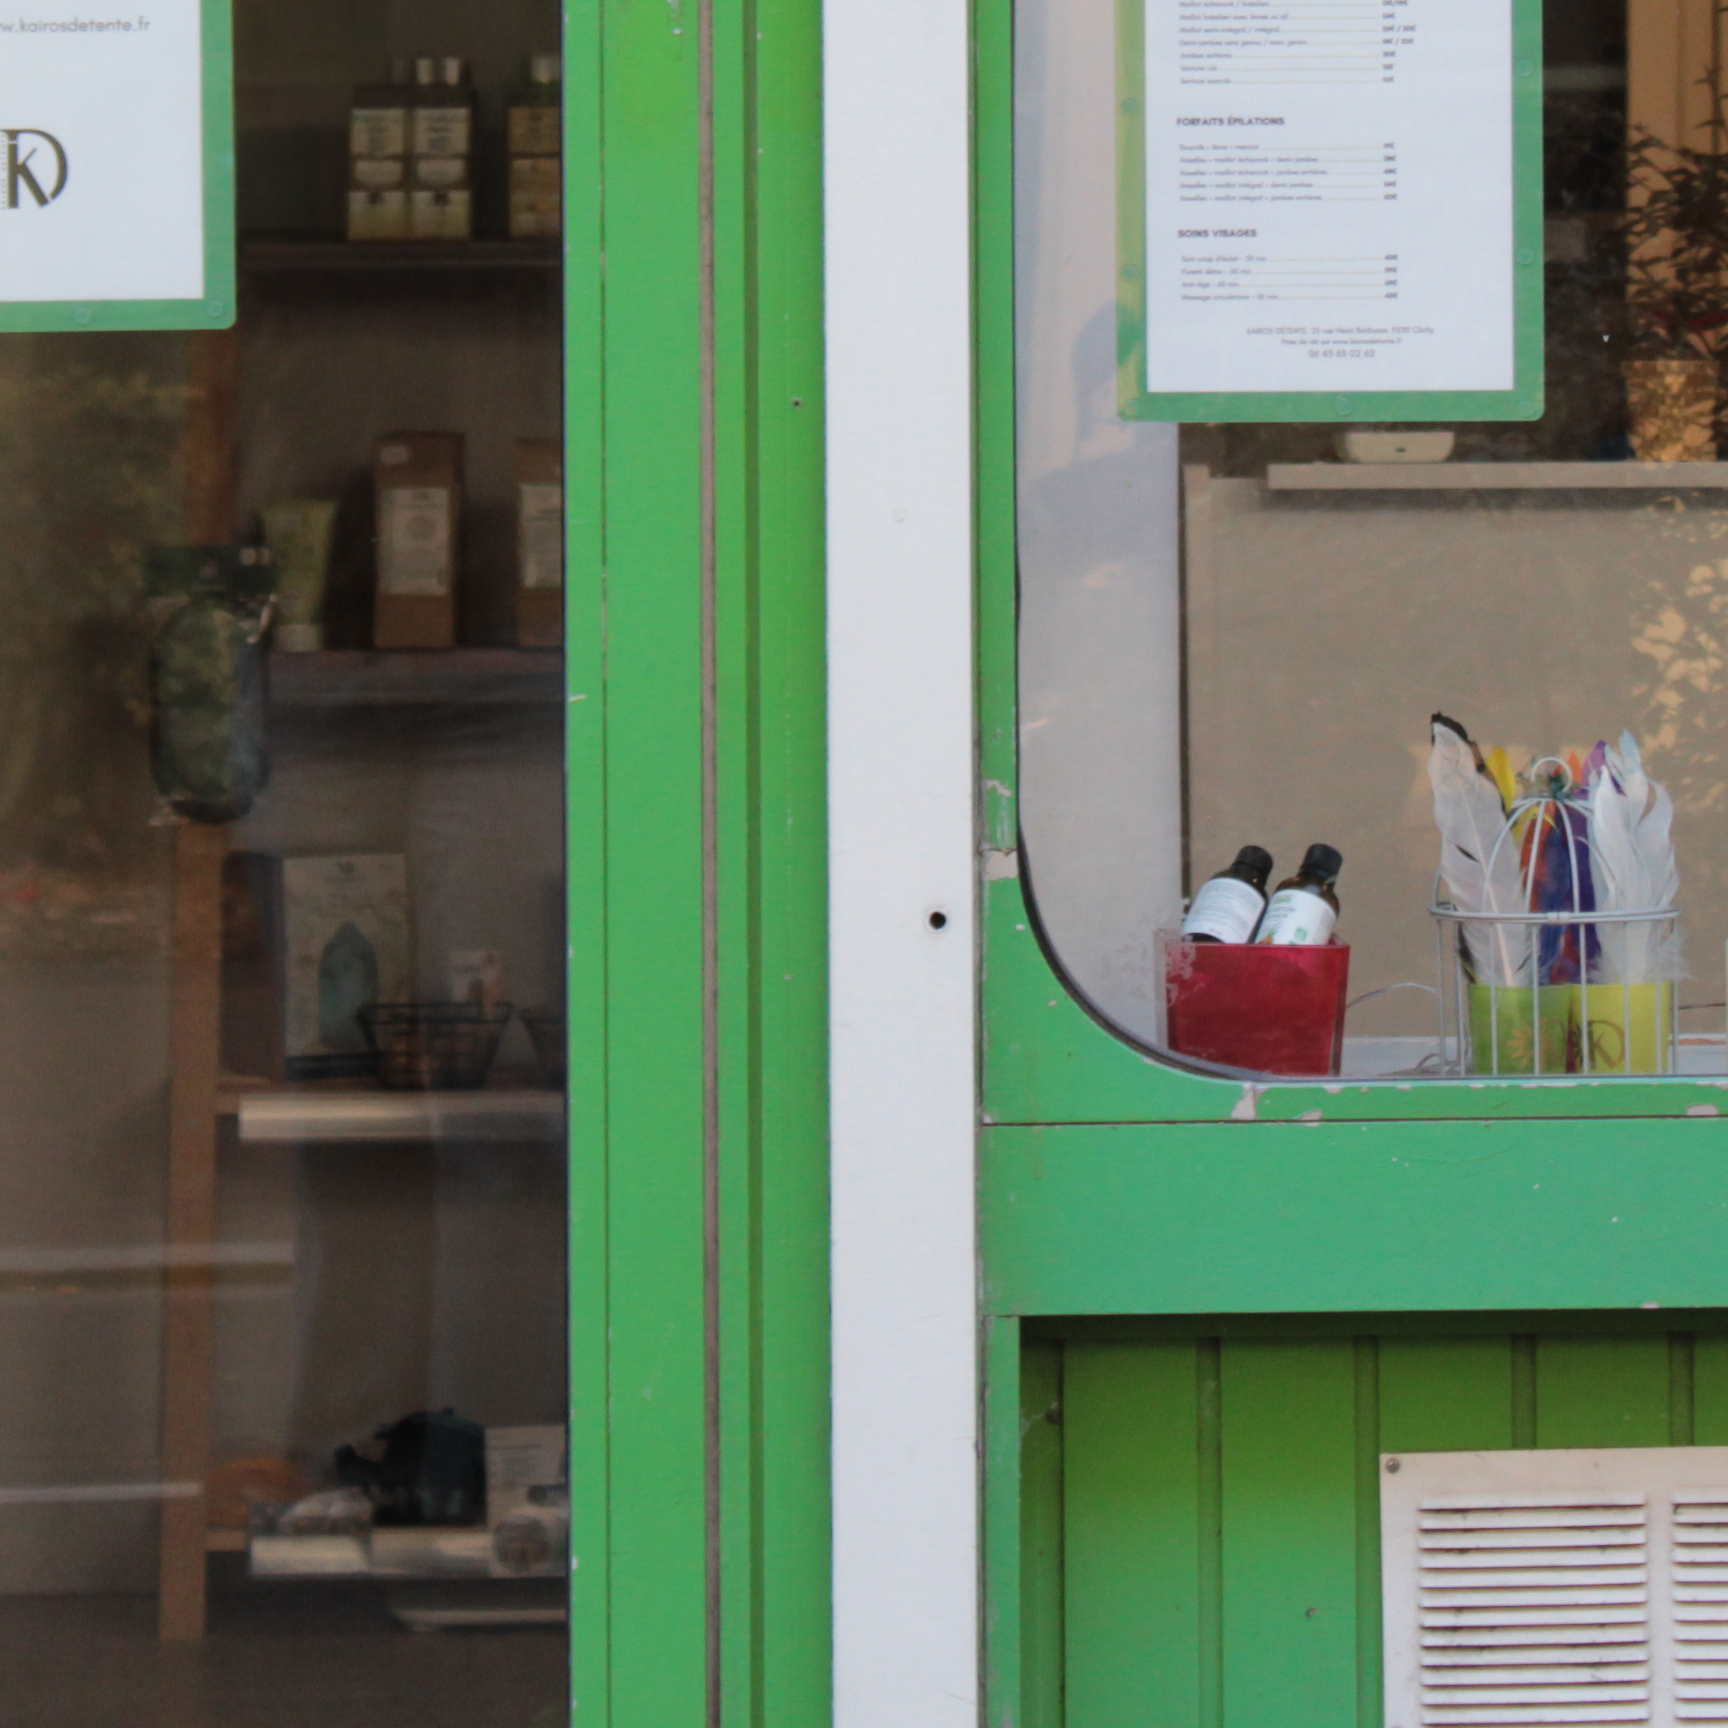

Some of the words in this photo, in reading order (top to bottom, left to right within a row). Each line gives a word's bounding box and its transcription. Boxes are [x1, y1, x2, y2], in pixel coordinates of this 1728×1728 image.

[1176, 117, 1225, 126] FORFAITS
[1227, 115, 1285, 126] ÉPILATIONS
[1177, 229, 1209, 238] SOINS
[1211, 228, 1257, 238] VISAGES
